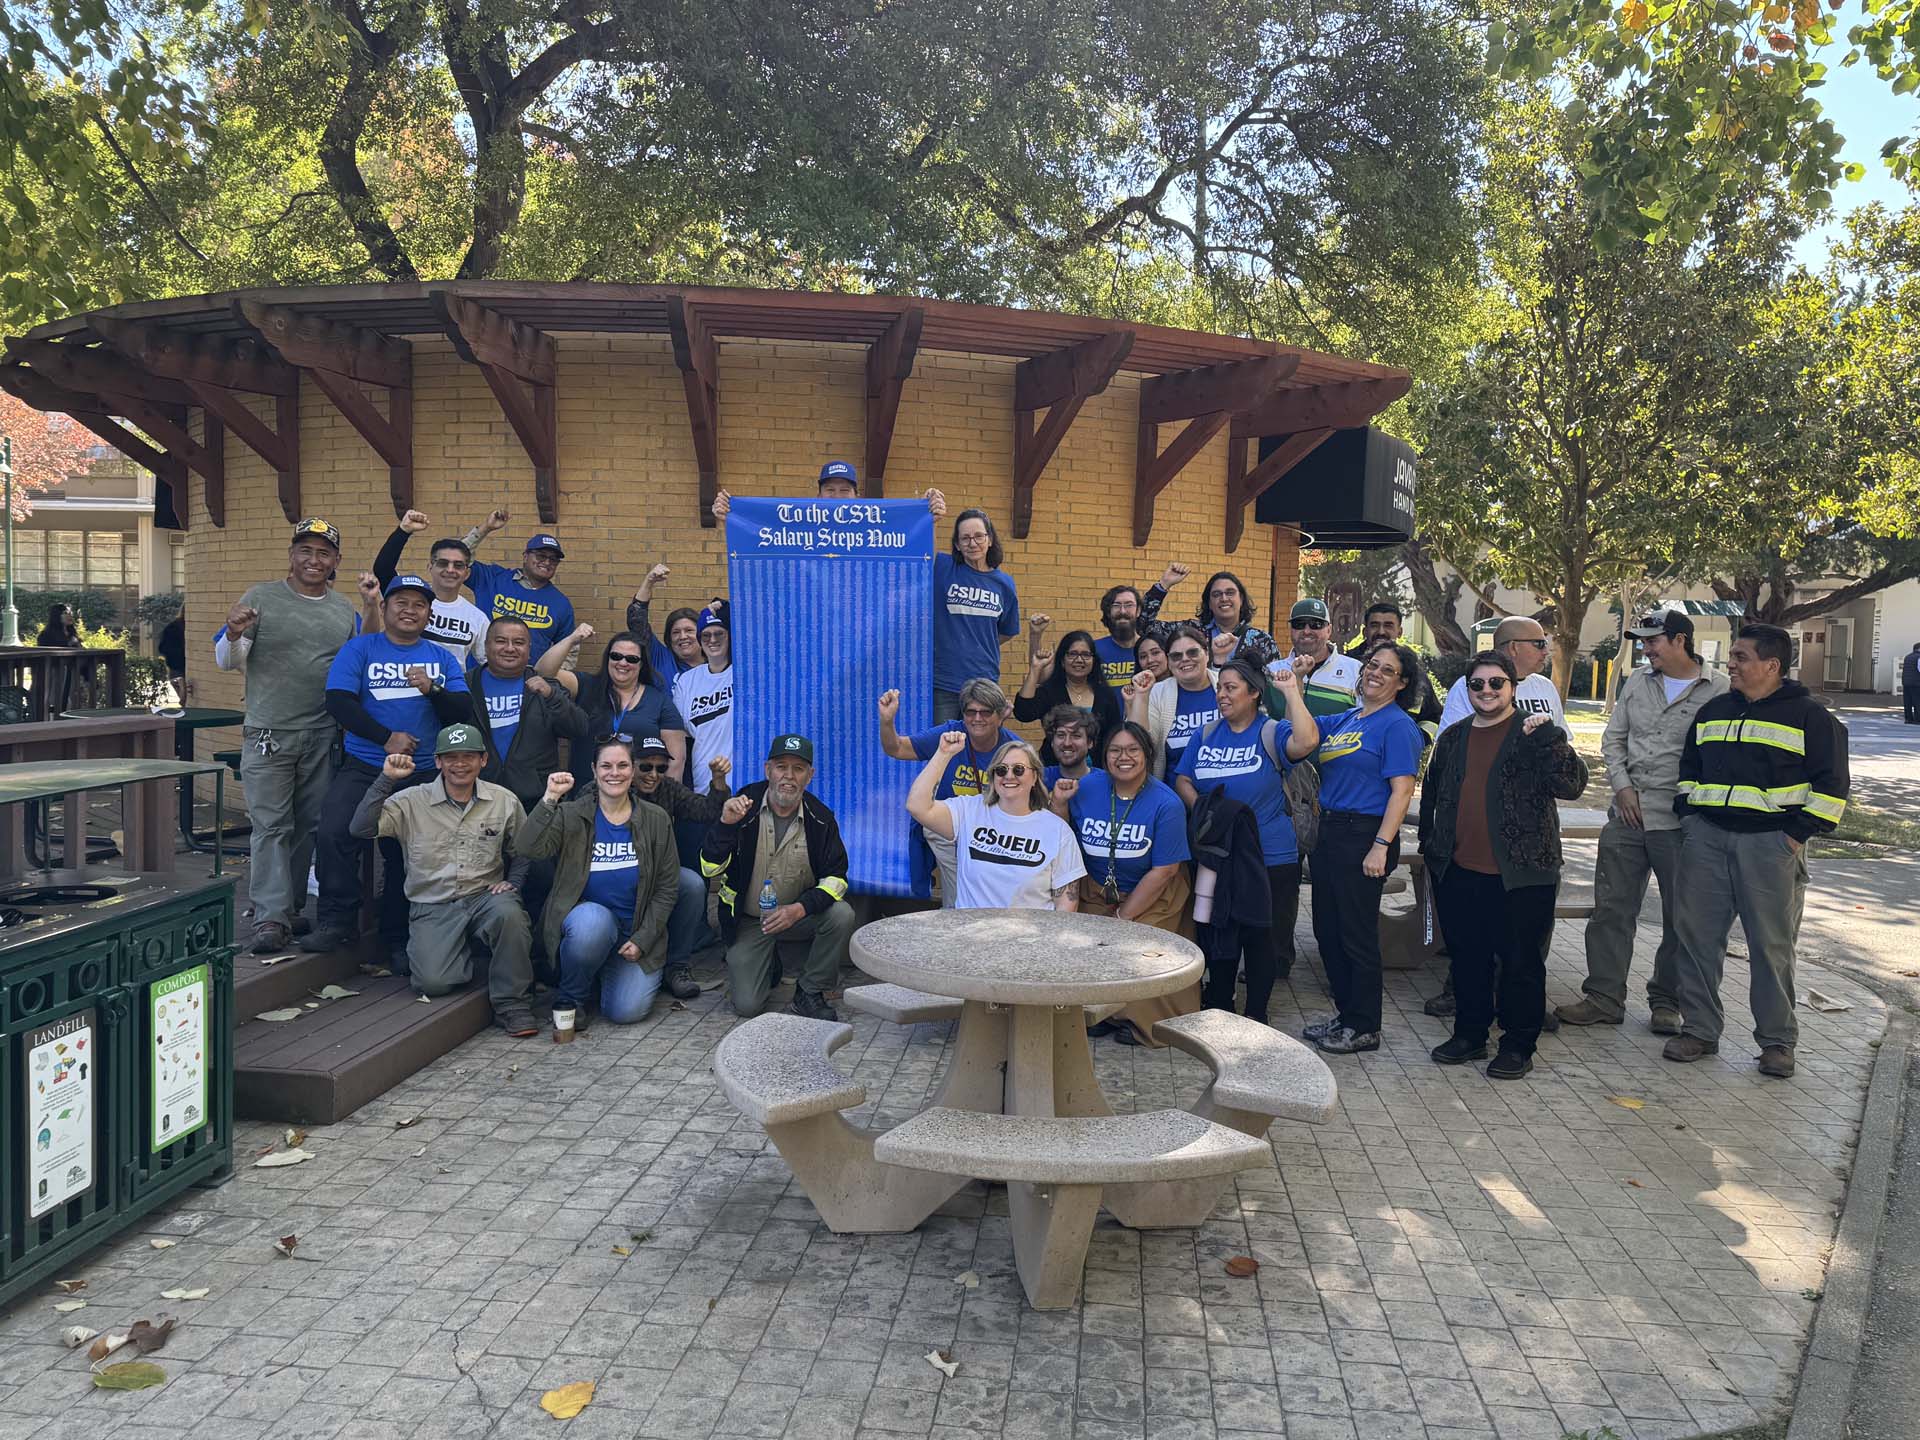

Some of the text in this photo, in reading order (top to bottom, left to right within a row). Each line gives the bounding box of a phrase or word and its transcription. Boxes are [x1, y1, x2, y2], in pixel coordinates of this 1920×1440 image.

[777, 504, 886, 525] To the CSU:
[758, 527, 906, 551] Salary Steps Now
[493, 593, 549, 618] CSUEU
[947, 583, 1000, 606] CSUEU
[429, 612, 470, 634] SUEU
[368, 662, 440, 680] CSUU
[1198, 744, 1257, 762] CSUEU
[592, 842, 636, 858] SUEU
[974, 827, 1041, 854] CSUEU
[157, 970, 201, 996] COMPOST
[34, 1016, 88, 1047] LANDFILL
